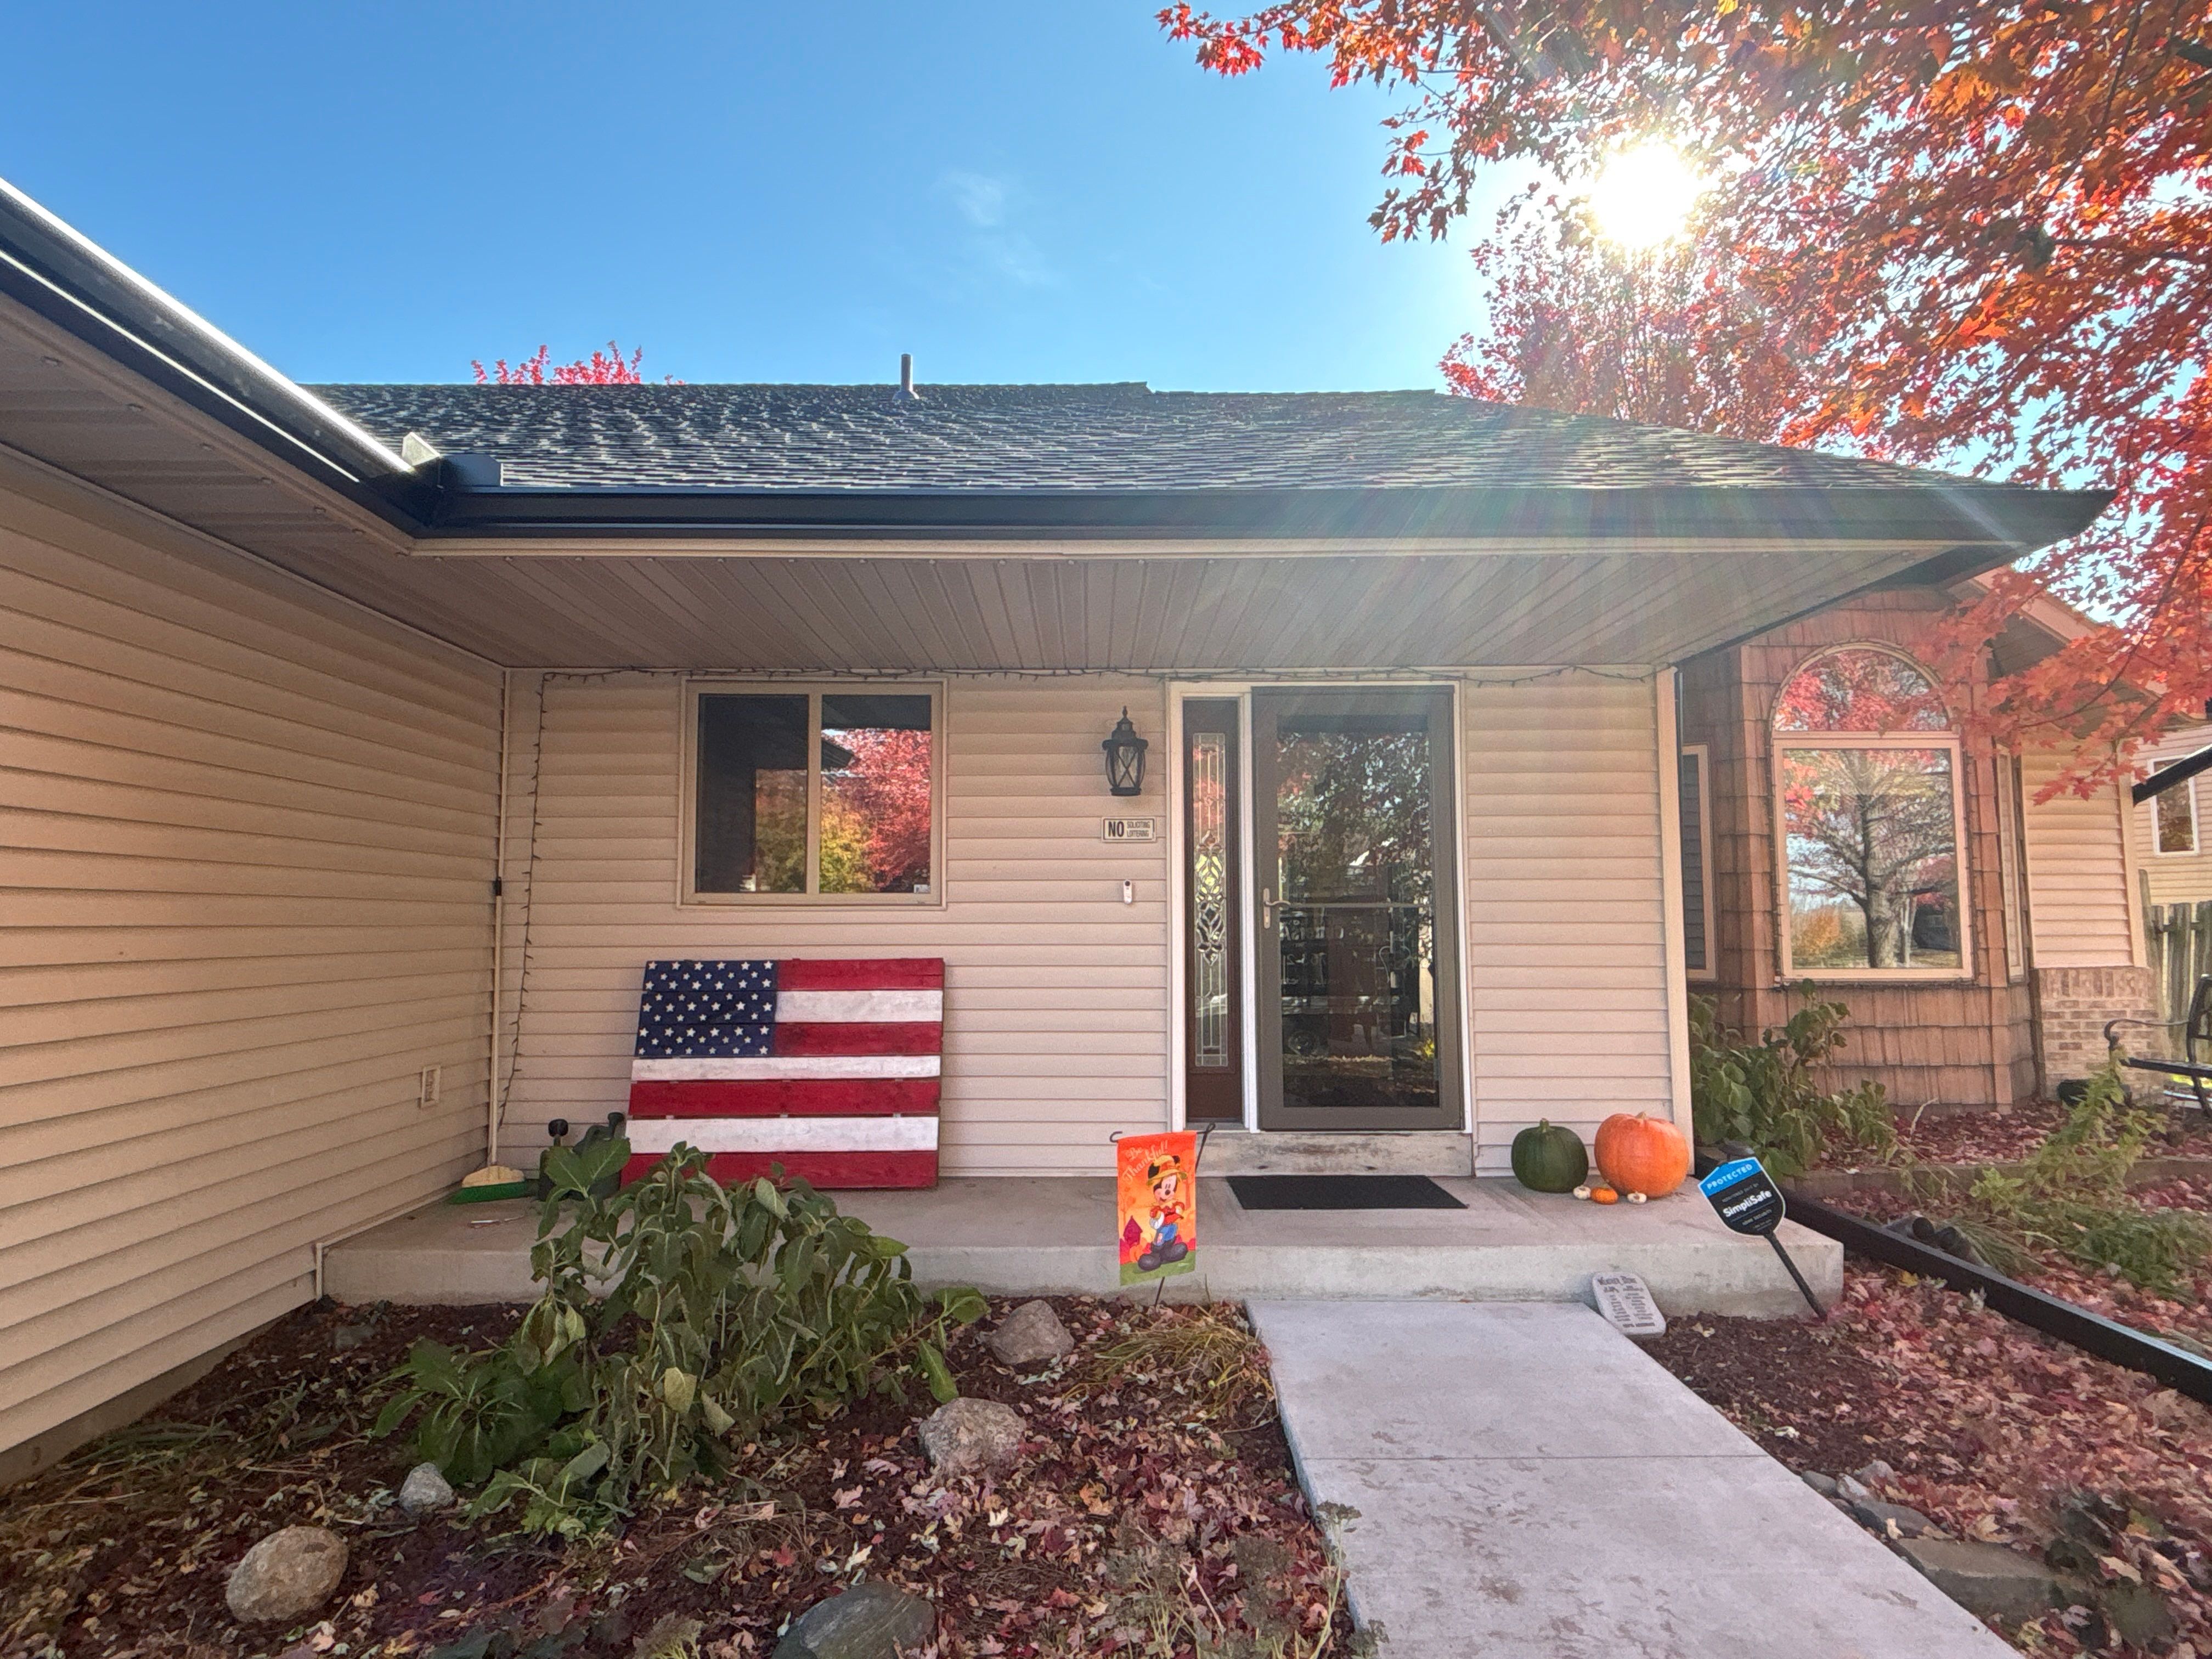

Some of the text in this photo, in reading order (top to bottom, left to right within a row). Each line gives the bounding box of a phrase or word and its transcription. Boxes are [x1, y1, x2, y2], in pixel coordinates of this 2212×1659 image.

[1108, 821, 1125, 837] NO
[1124, 1147, 1143, 1162] Be
[1707, 1164, 1753, 1190] PROTECTED
[1723, 1190, 1772, 1217] SimpliSafe
